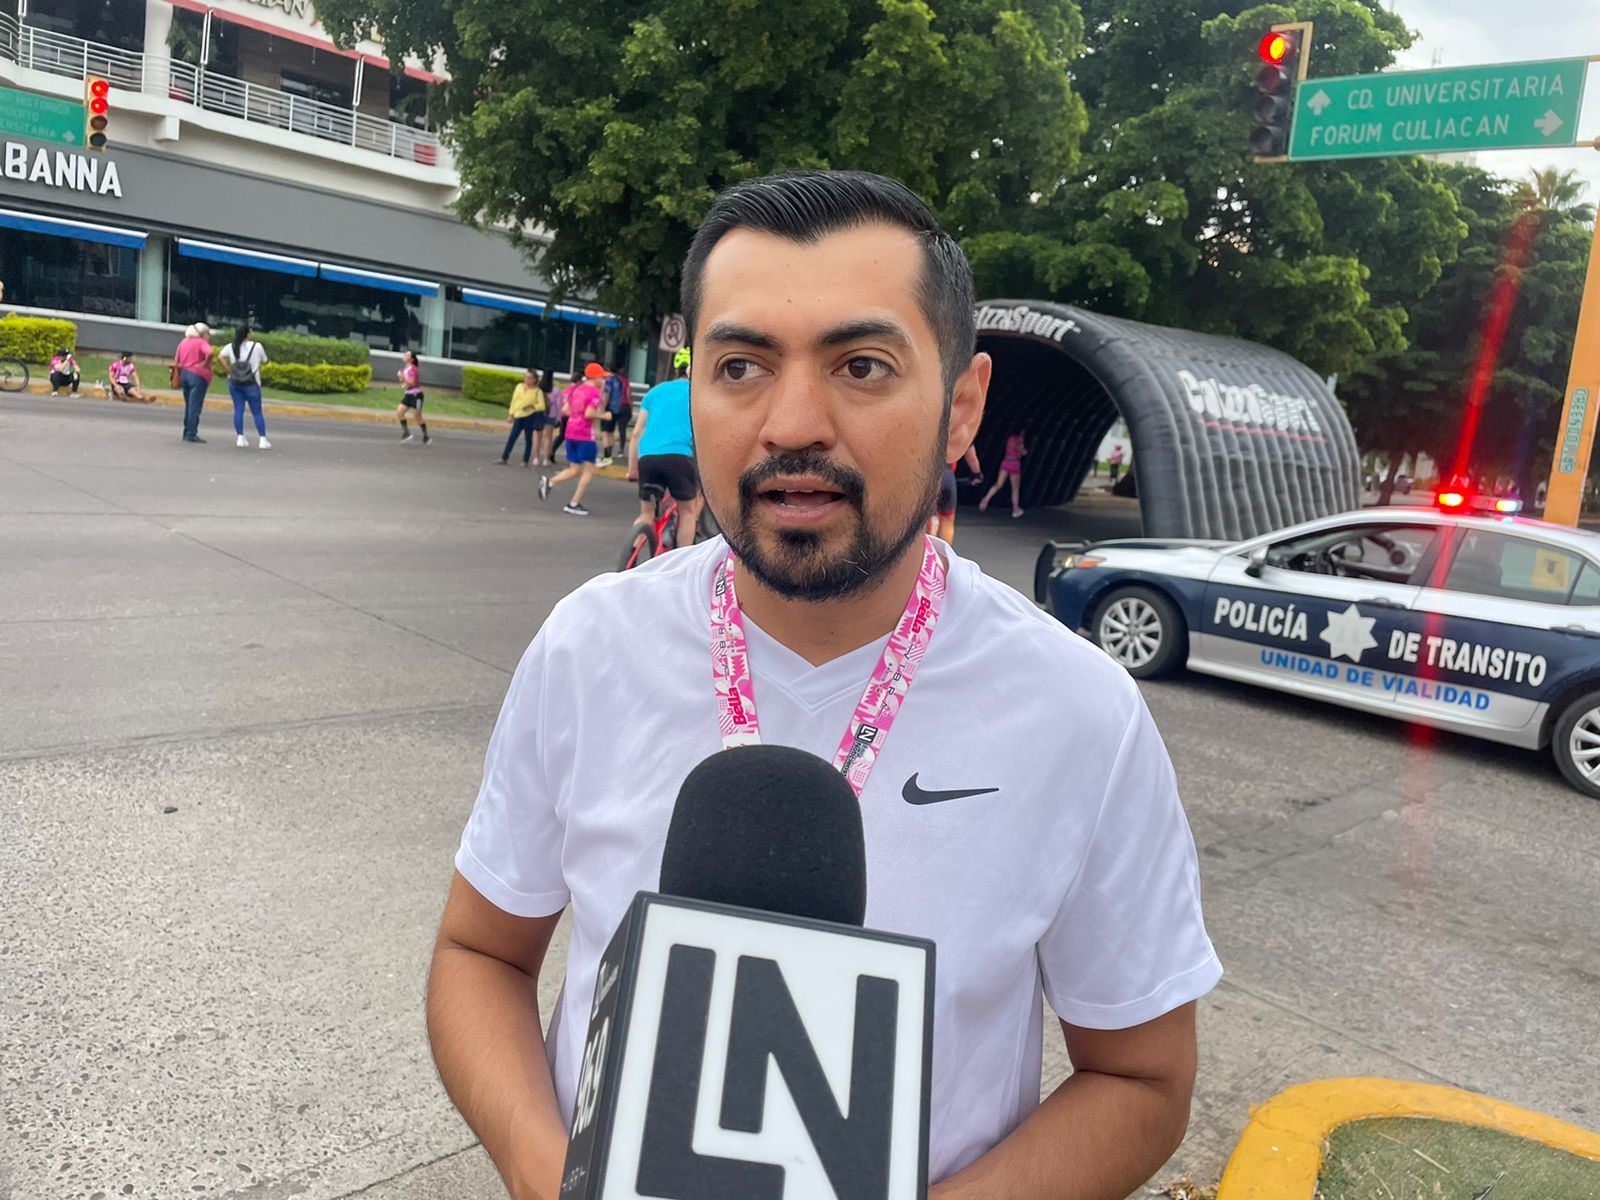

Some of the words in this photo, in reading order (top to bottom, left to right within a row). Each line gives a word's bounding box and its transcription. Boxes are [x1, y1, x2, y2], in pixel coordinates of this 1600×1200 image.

[1347, 88, 1374, 110] CD.
[1386, 73, 1565, 107] UNIVERSITARIA
[1310, 122, 1383, 147] FORUM
[1392, 113, 1511, 141] CULIACAN
[0, 141, 123, 198] BANNA
[912, 596, 931, 634] Bella
[1214, 596, 1308, 632] POLICÍA
[1388, 629, 1422, 663] DE
[1426, 635, 1547, 687] TRANSITO
[1260, 649, 1339, 680] UNIDAD
[1346, 667, 1374, 687] DE
[1382, 674, 1490, 710] VIALIDAD
[727, 687, 748, 725] Bella
[635, 943, 899, 1200] LN
